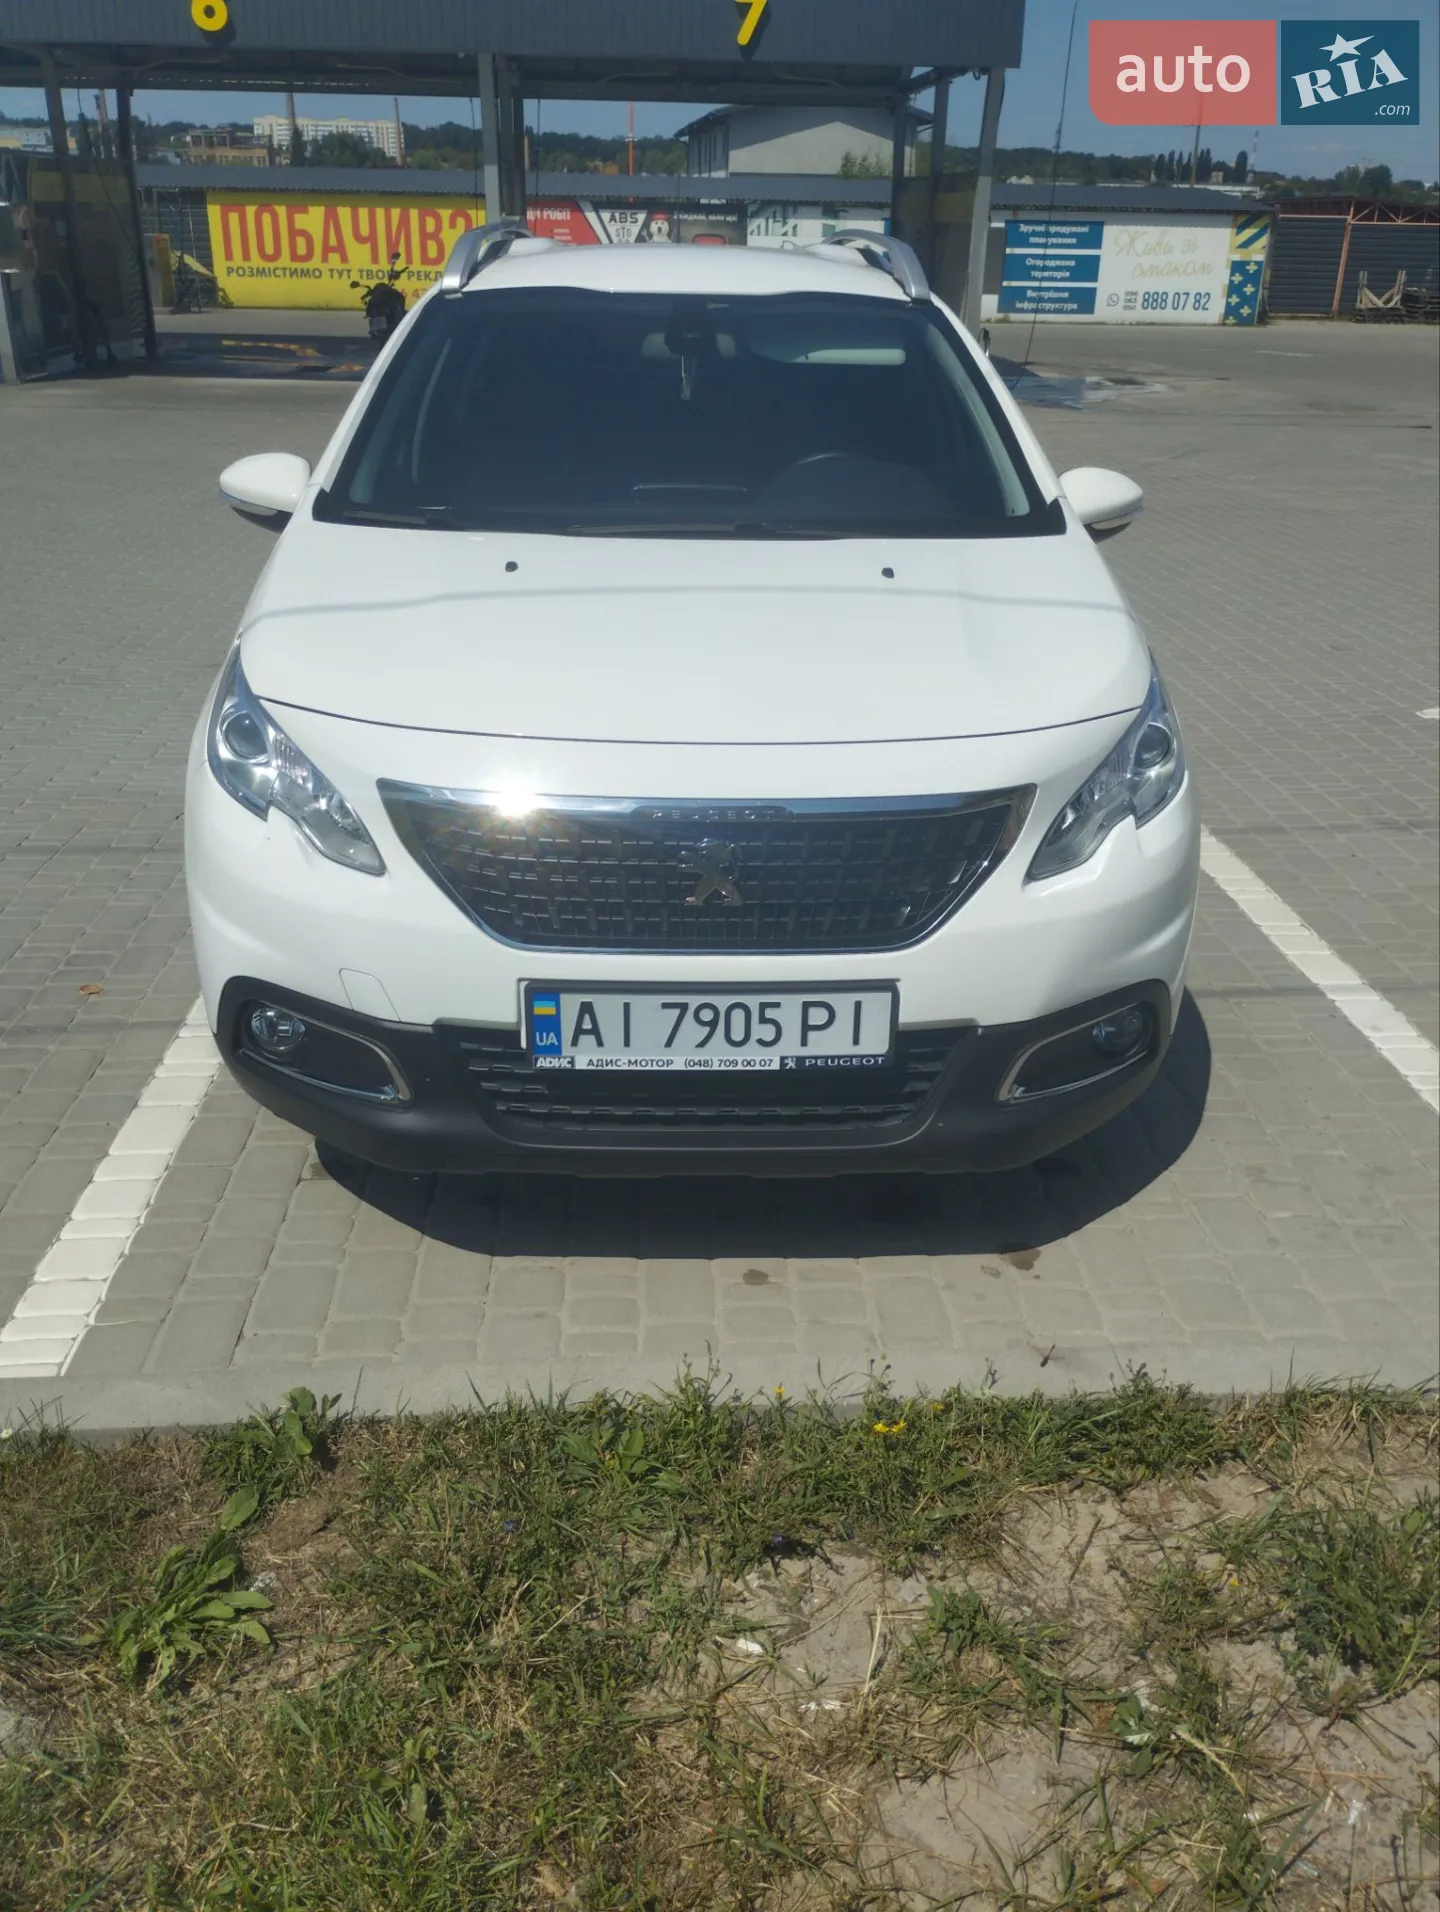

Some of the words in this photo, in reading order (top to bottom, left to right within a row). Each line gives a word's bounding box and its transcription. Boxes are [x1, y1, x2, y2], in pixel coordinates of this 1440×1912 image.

[736, 0, 768, 46] 7
[608, 211, 640, 224] ABS
[226, 266, 323, 280] РОЗМІСТИМО
[327, 268, 353, 280] ТУТ
[407, 270, 444, 282] РЕКЛ
[1141, 291, 1169, 311] 888
[1171, 292, 1190, 311] 07
[1192, 292, 1212, 312] 82
[570, 1000, 632, 1048] AI
[660, 1001, 783, 1048] 7905
[801, 1000, 863, 1048] PI
[535, 1031, 559, 1047] UA
[586, 1058, 674, 1068] АДИС-МОТОР
[684, 1058, 714, 1069] (048)
[717, 1058, 739, 1068] 709
[741, 1058, 757, 1068] 00
[758, 1058, 774, 1068] 07
[805, 1057, 887, 1067] PEUGEOT
